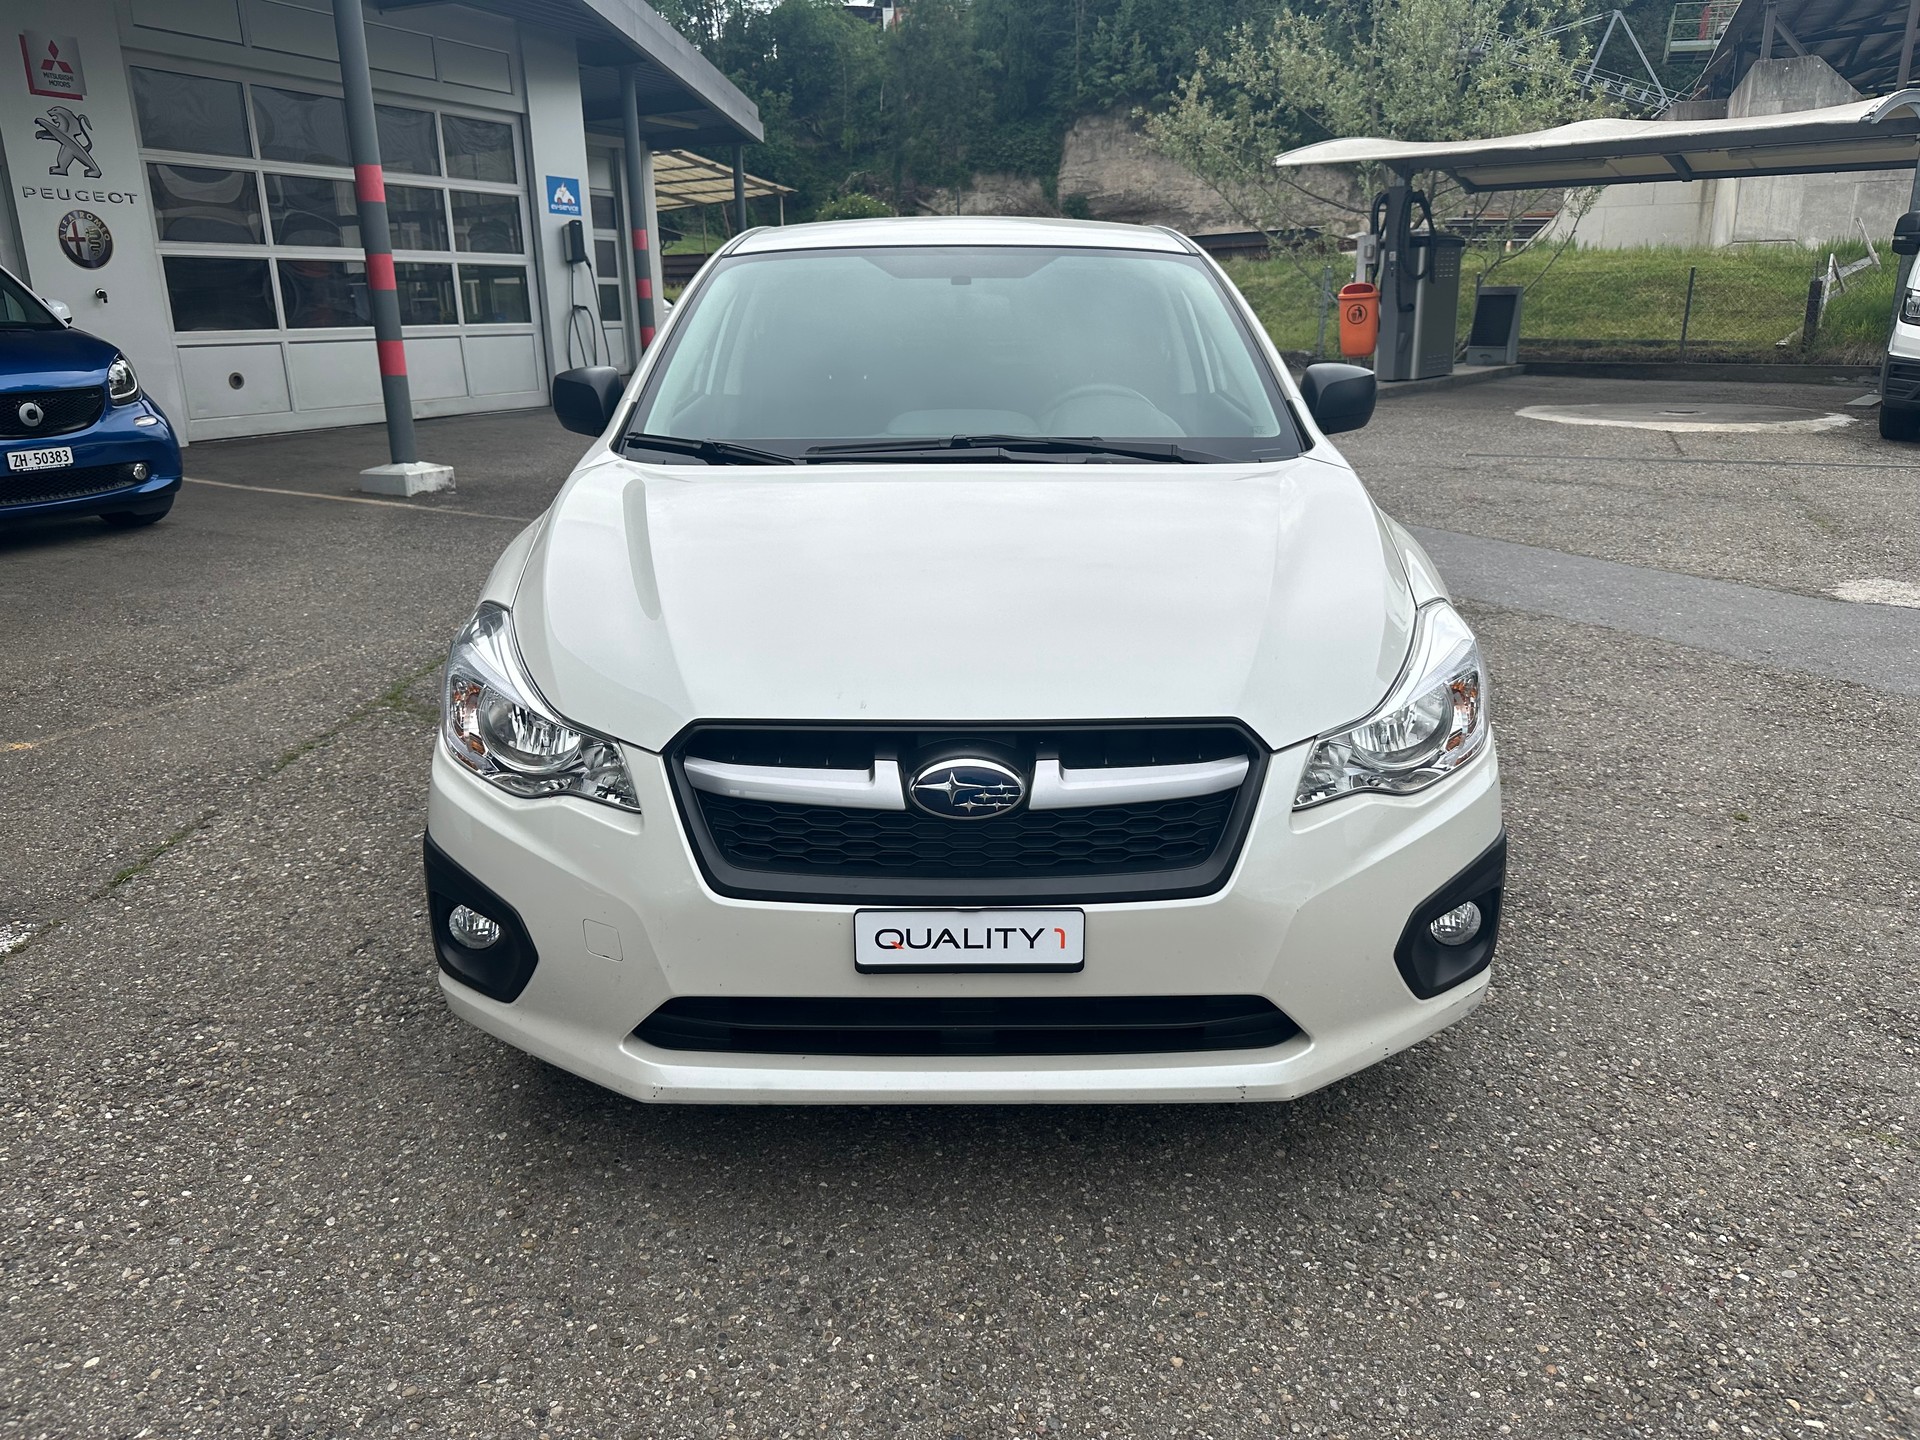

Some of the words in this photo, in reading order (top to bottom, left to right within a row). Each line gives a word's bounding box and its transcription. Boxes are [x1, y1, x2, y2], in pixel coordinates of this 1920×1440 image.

[43, 72, 74, 82] MITSUBISHI
[48, 80, 71, 88] MOTORS
[22, 186, 138, 204] PEUGEOT
[60, 214, 76, 240] ALFA
[79, 211, 111, 241] ROMEO
[874, 927, 1045, 950] QUALITY
[1053, 927, 1066, 949] 1
